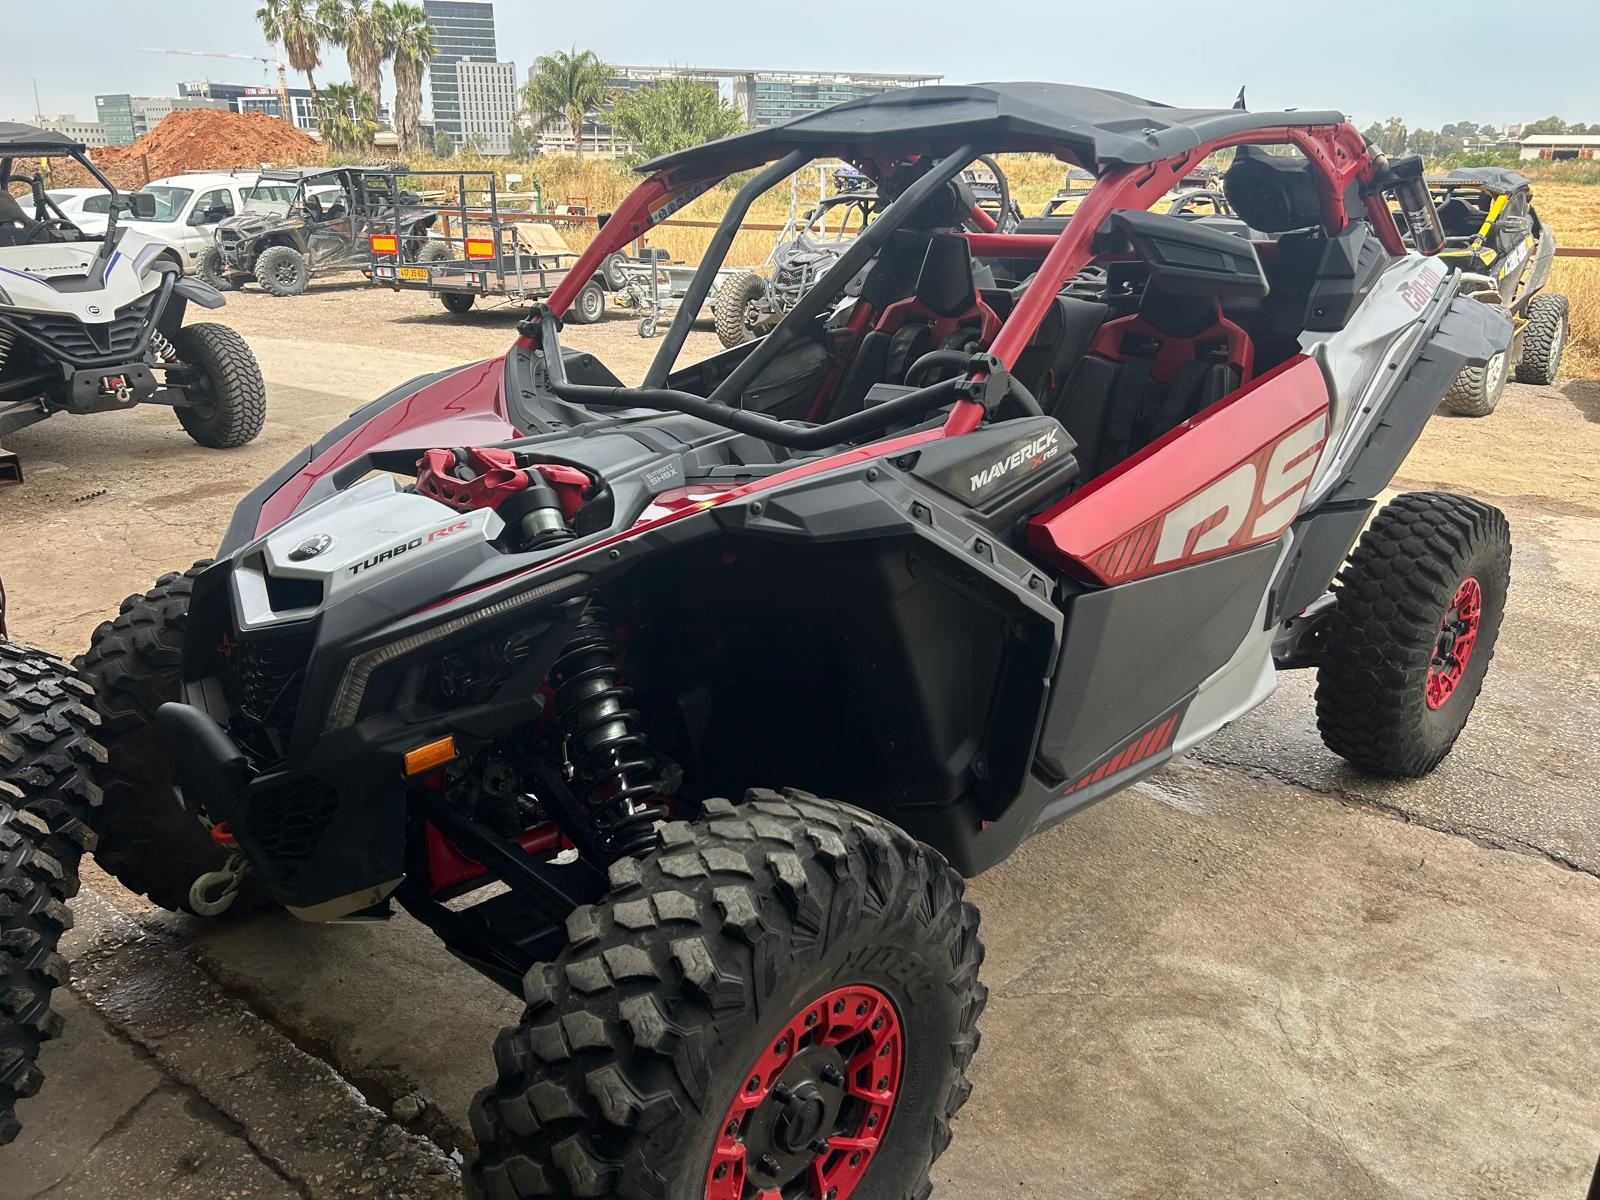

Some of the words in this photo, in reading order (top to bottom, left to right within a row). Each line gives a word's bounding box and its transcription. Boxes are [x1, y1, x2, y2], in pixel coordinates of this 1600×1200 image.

[1407, 206, 1435, 236] FOX
[1401, 265, 1441, 314] can-am
[646, 462, 673, 479] SMART
[650, 467, 678, 486] SHOX
[970, 427, 1059, 492] MAVERICK
[1153, 412, 1327, 565] RS
[348, 537, 423, 575] TURBO
[427, 520, 468, 542] RR
